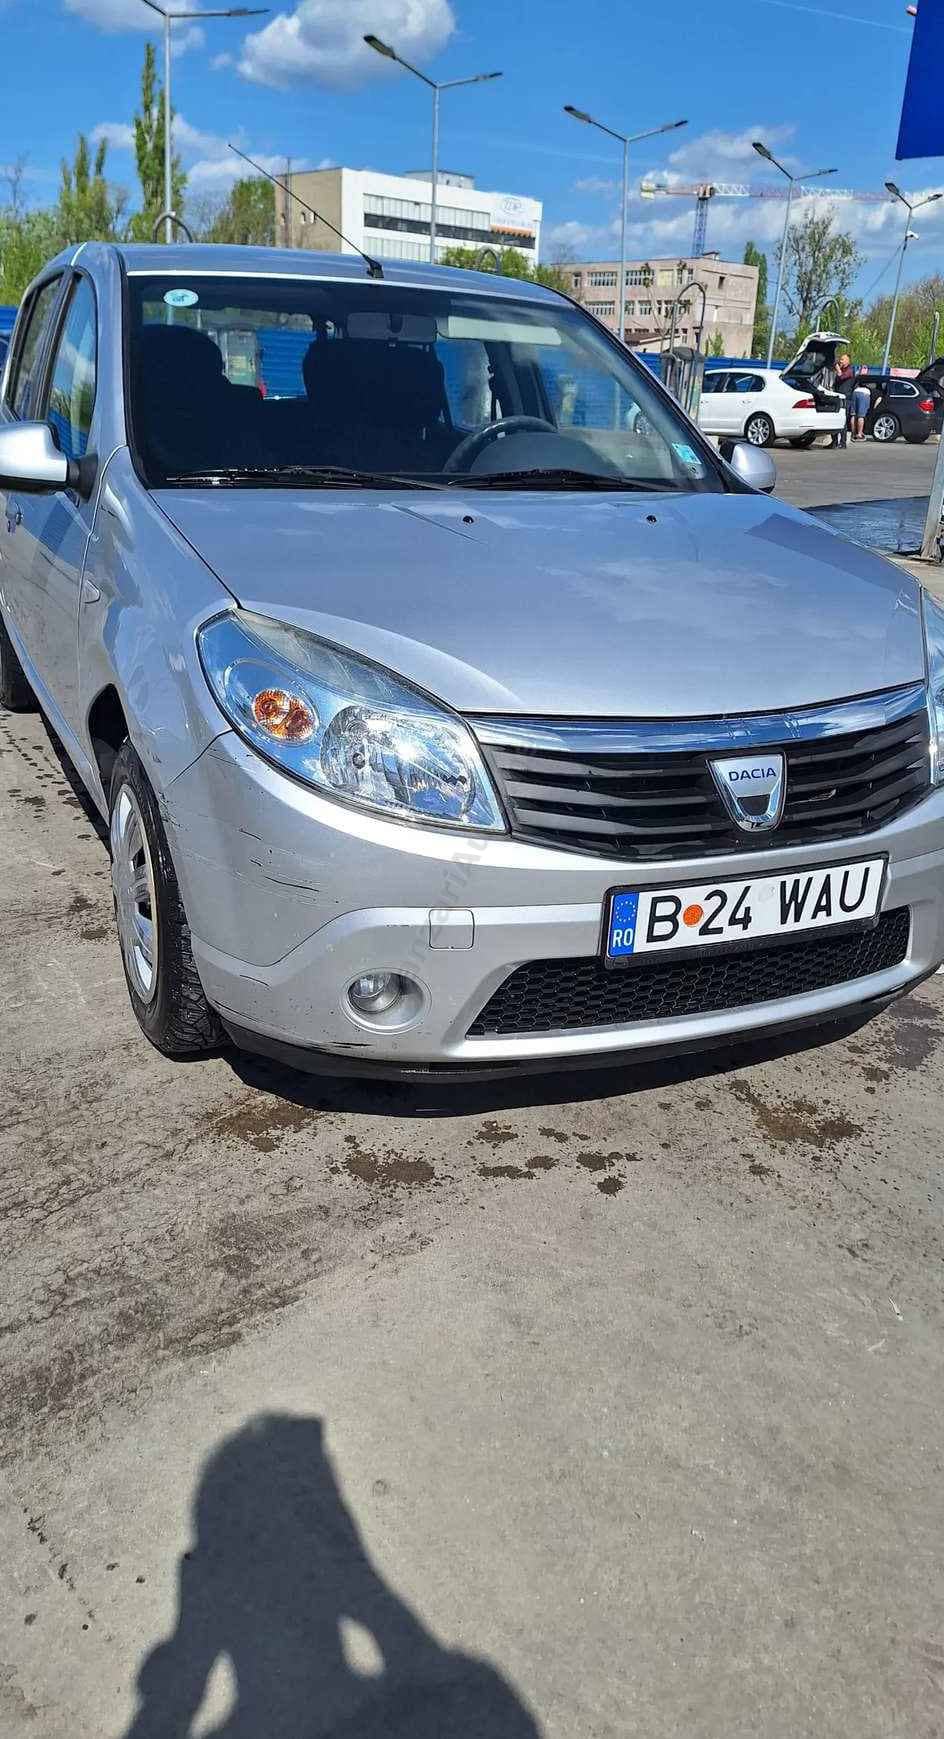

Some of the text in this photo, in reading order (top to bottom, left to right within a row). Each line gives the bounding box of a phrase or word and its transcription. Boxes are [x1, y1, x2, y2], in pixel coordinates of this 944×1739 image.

[728, 767, 777, 782] DACIA
[646, 866, 871, 943] B 24 WAU
[612, 928, 634, 948] RO
